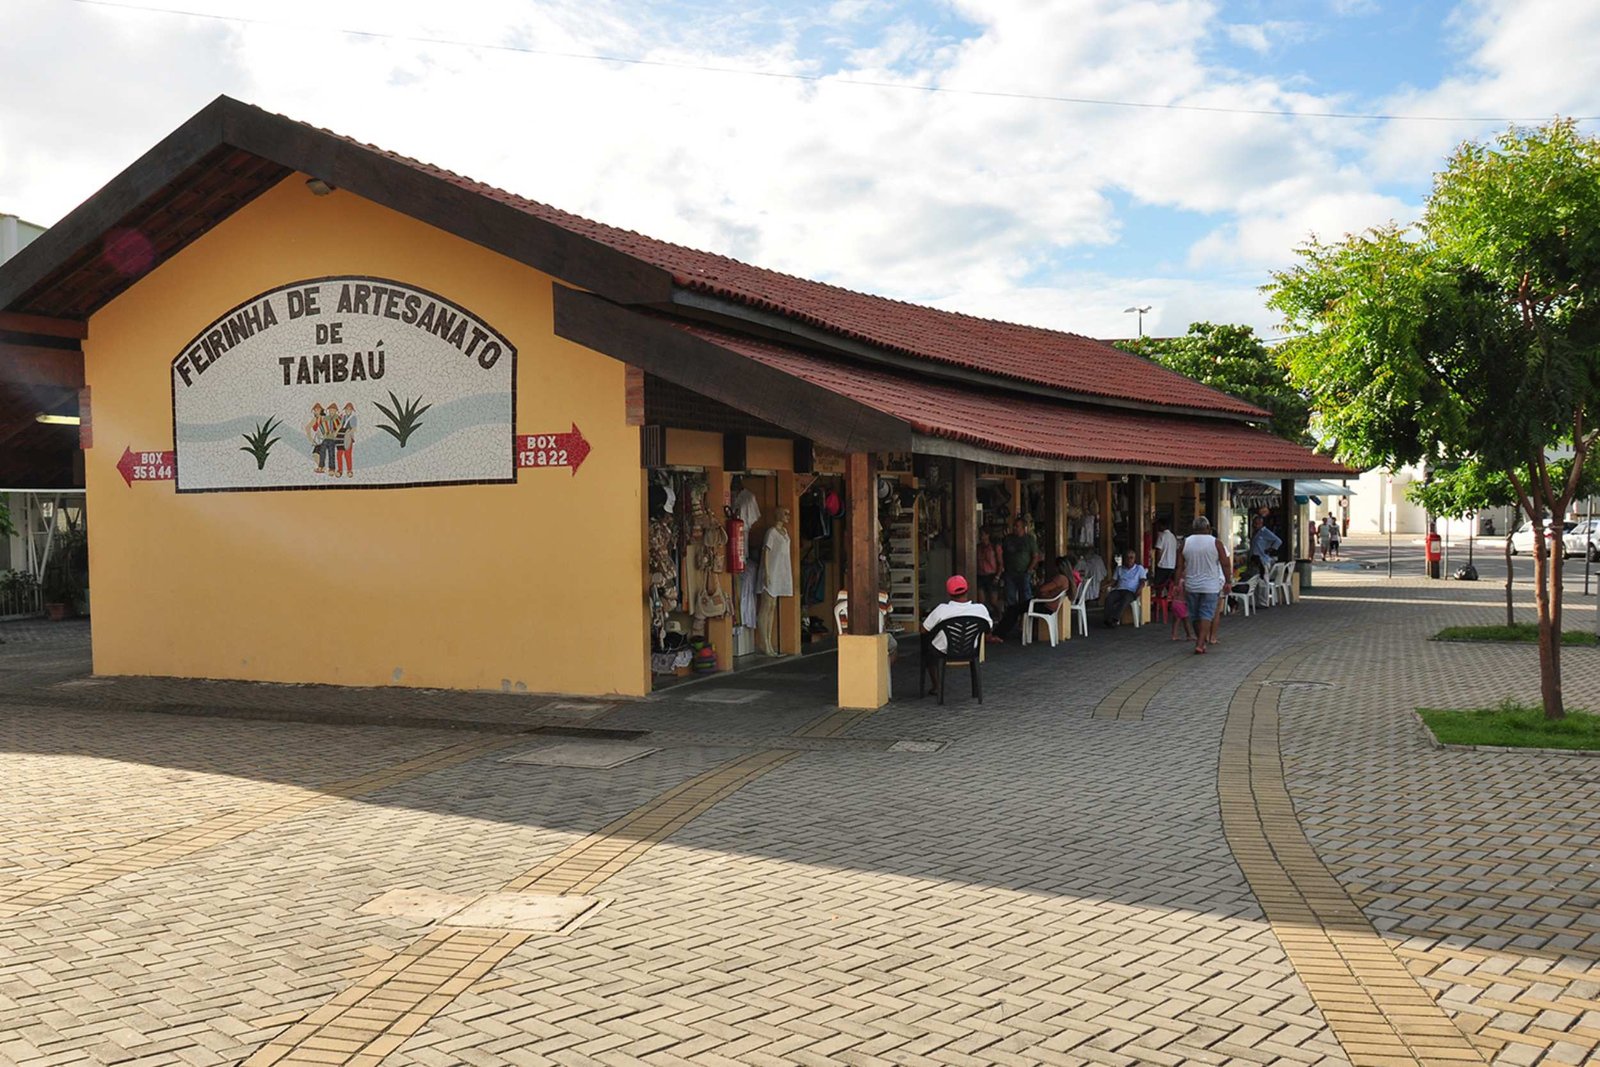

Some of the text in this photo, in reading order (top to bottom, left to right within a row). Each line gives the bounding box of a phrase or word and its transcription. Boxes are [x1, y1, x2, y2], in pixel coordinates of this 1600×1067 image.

[176, 284, 502, 387] FEIRINHA DE ARTESANATO
[316, 322, 343, 345] DE
[279, 339, 385, 386] TAMBAÚ
[527, 436, 556, 449] BOX
[142, 453, 162, 464] BOX
[519, 450, 567, 466] 13 a 22
[133, 466, 171, 478] 35 a 44
